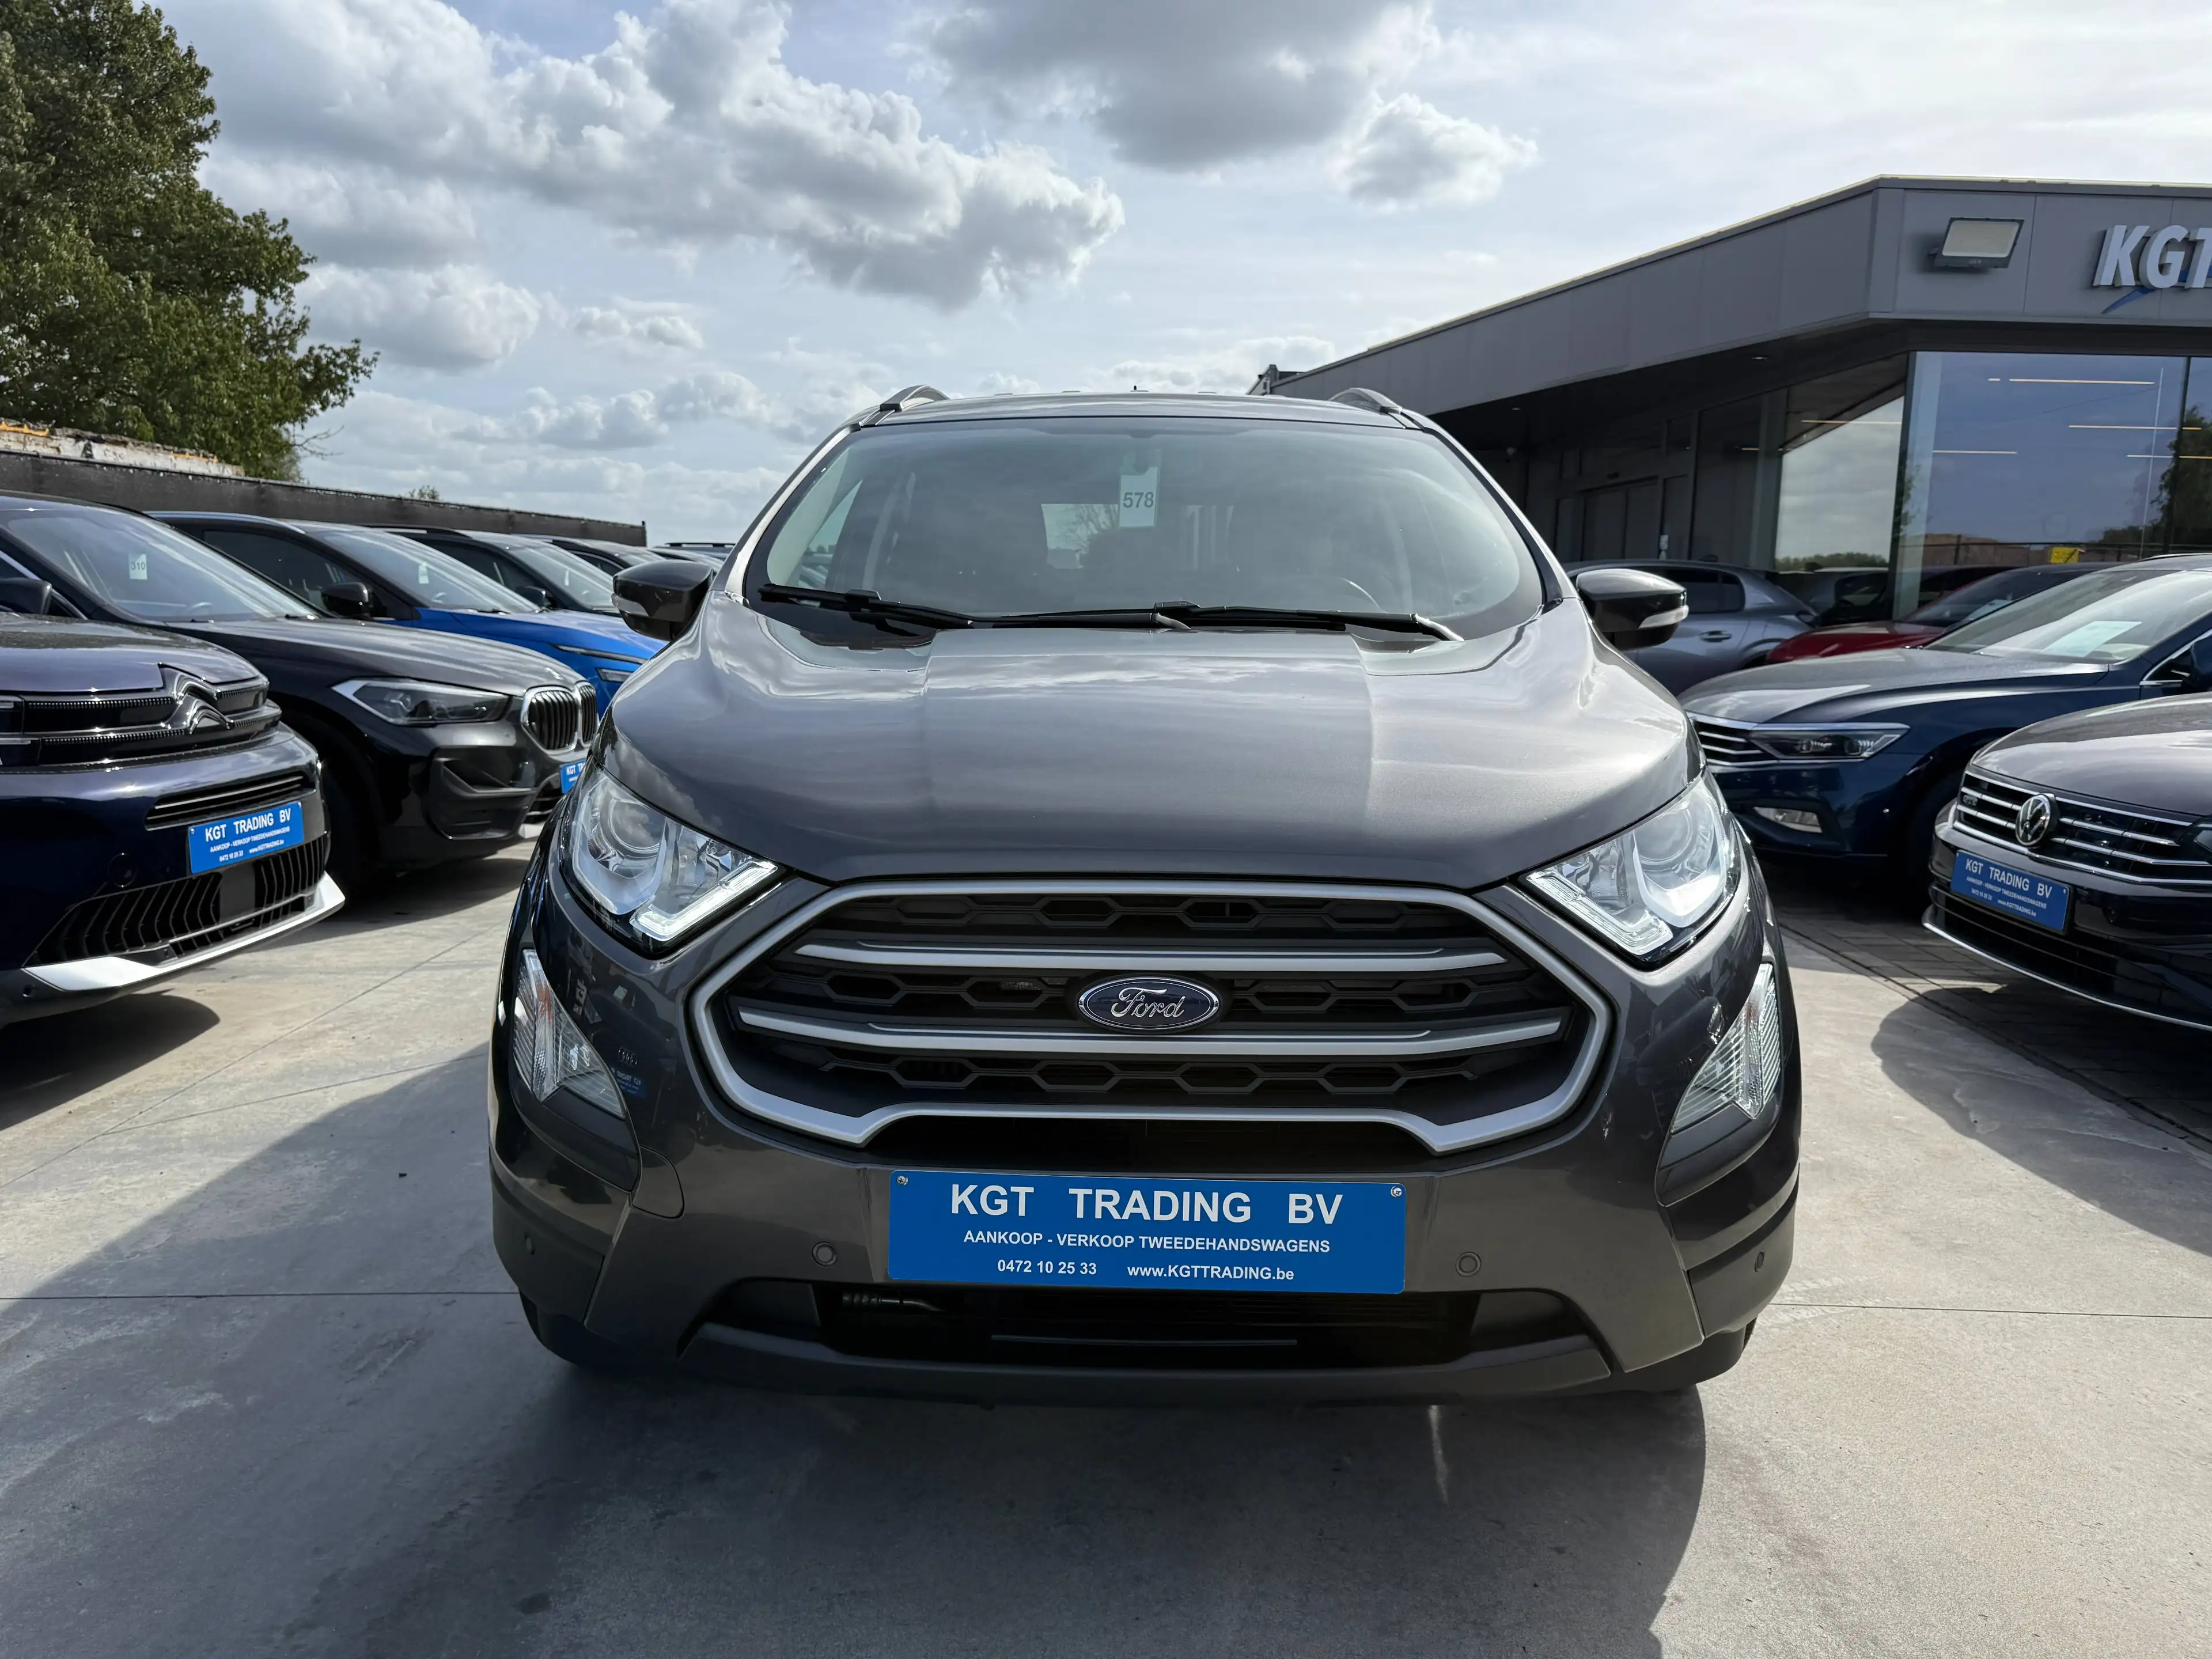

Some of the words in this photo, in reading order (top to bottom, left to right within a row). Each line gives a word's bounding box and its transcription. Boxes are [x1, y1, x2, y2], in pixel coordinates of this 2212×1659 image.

[2093, 225, 2212, 289] KGT
[1123, 491, 1154, 508] 578
[130, 561, 146, 570] 310
[205, 824, 227, 842] KGT
[233, 813, 274, 834] TRADING
[279, 808, 291, 823] BV
[1965, 858, 1984, 875] KGT
[1989, 866, 2029, 891] TRADING
[2037, 882, 2052, 899] BV
[1111, 987, 1186, 1018] Ford
[952, 1184, 1035, 1217] KGT
[1069, 1188, 1251, 1223] TRADING
[1288, 1194, 1343, 1224] BV
[963, 1230, 1043, 1245] AANKOOP
[1056, 1233, 1134, 1248] VERKOOP
[1138, 1236, 1330, 1253] TWEEDEHANDSWAGENS
[998, 1259, 1032, 1272] 0472
[1037, 1260, 1054, 1274] 10
[1058, 1262, 1075, 1274] 25
[1080, 1262, 1097, 1275] 33
[1127, 1264, 1294, 1280] www.KGTTRADING.be
